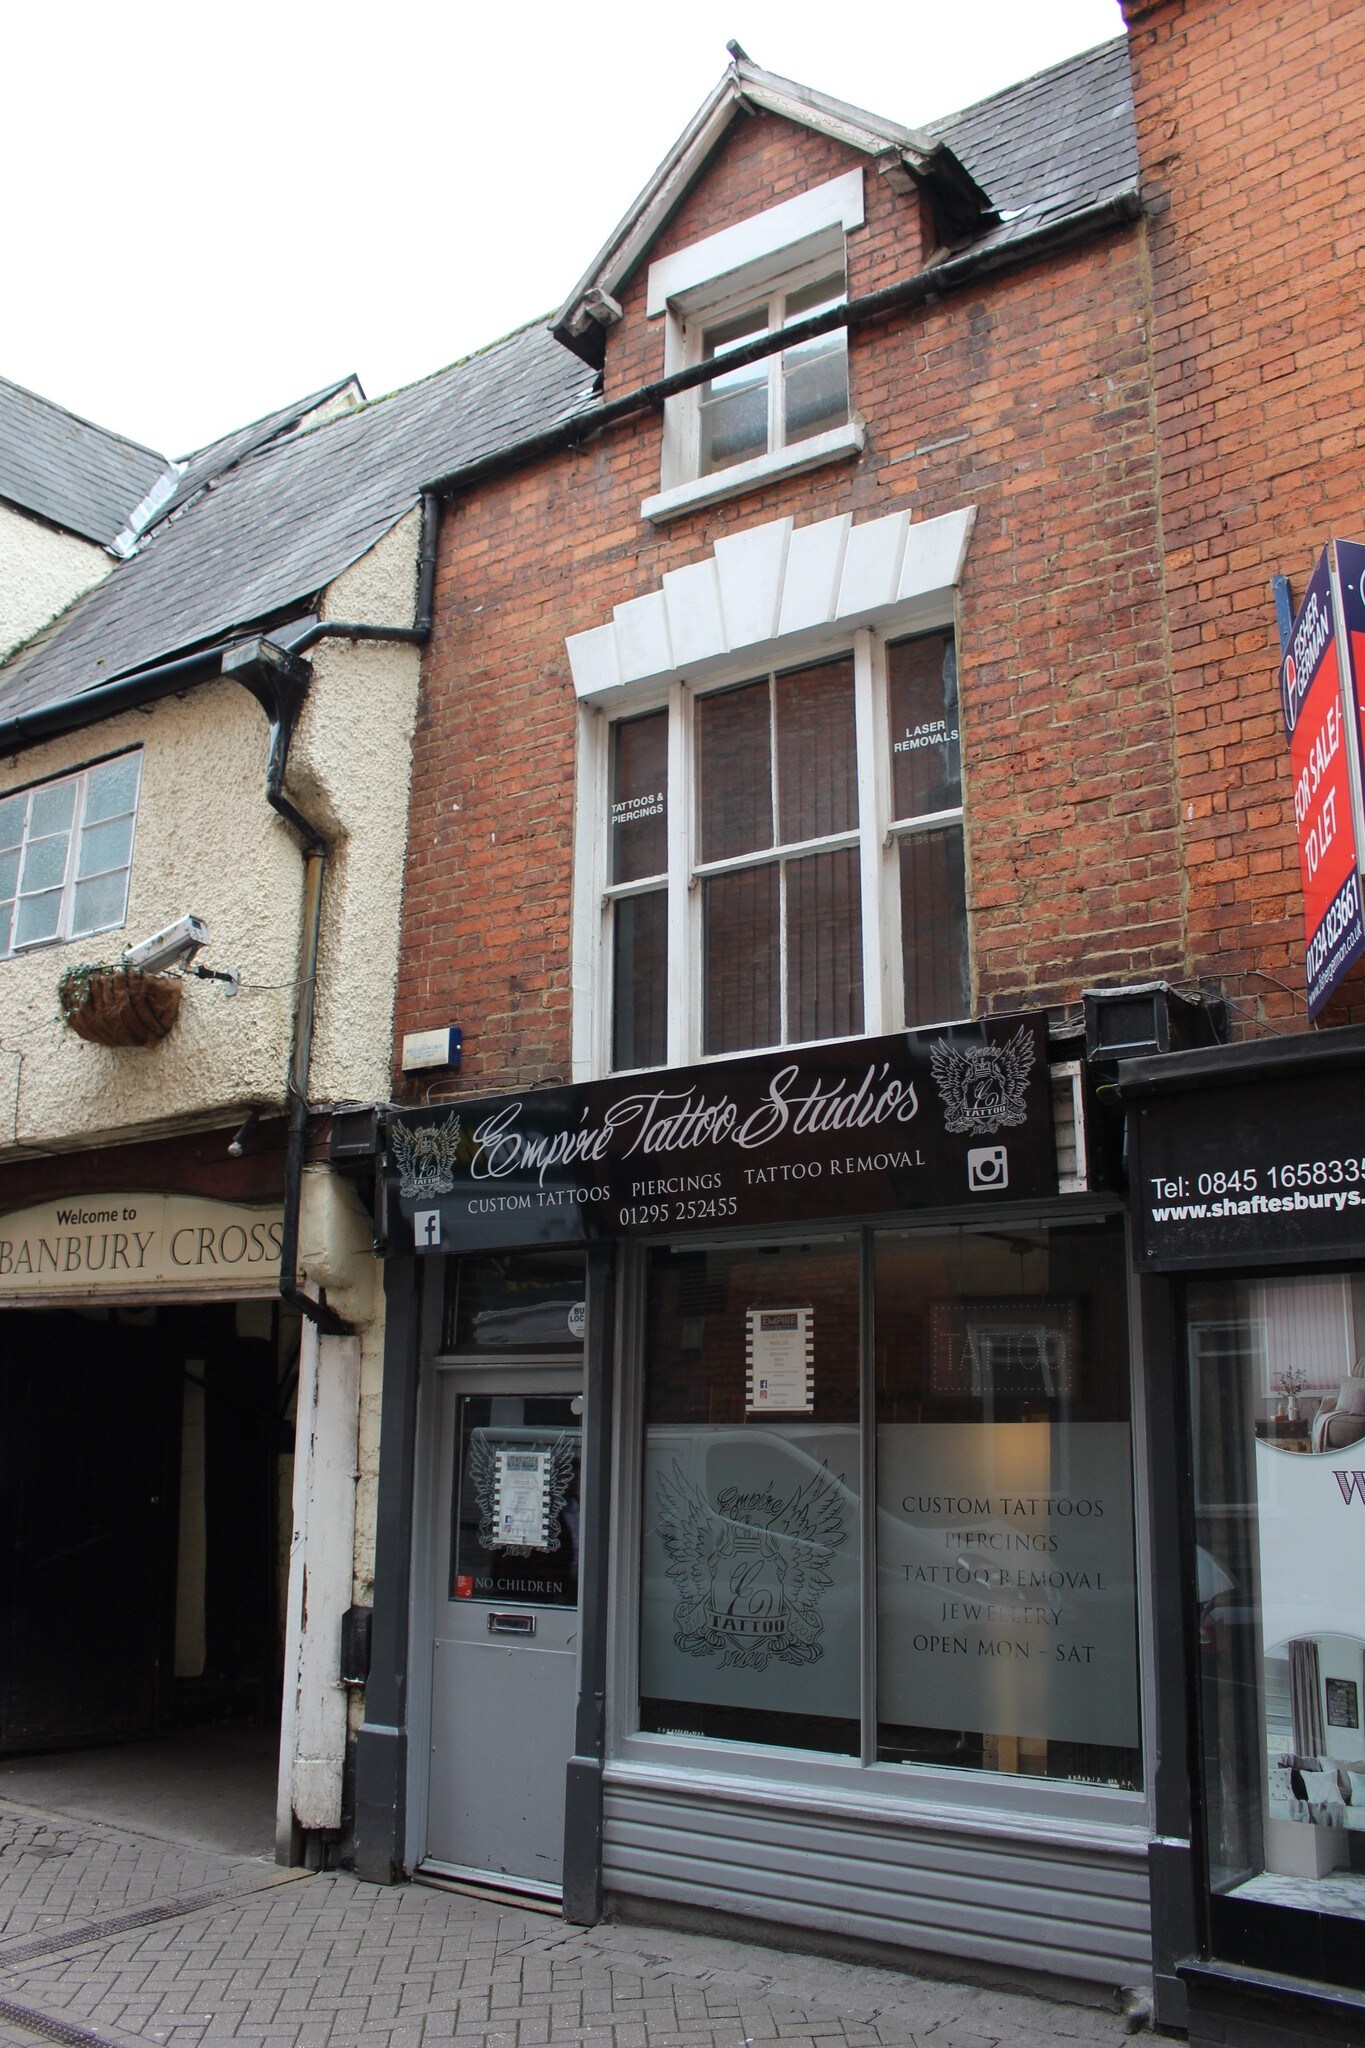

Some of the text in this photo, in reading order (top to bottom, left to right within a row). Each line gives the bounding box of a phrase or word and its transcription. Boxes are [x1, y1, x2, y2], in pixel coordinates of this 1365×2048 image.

[1293, 592, 1319, 669] FISHER
[1297, 605, 1329, 697] GERMAN
[894, 729, 959, 752] REMOVALS
[905, 720, 945, 738] LASER
[611, 792, 664, 813] TATTOOS &
[1294, 766, 1311, 834] FOR
[611, 804, 664, 825] PIERCINGS
[1305, 785, 1337, 882] TO LET
[1306, 873, 1359, 983] 01234 823661
[964, 1105, 1006, 1117] TATTOO
[470, 1062, 919, 1188] Empire Tattoo Studios
[413, 1176, 440, 1185] TATTOO
[468, 1150, 926, 1214] CUSTOM TATTOOS PIERCINGS TATTOO REMOVAL
[1151, 1175, 1190, 1199] Tel:
[1198, 1168, 1258, 1196] 0845
[57, 1207, 137, 1225] Welcome to
[619, 1197, 738, 1226] 01295 252455
[1151, 1190, 1365, 1222] www.shaftesburys.
[0, 1222, 284, 1275] BANBURY CROSS
[762, 1315, 796, 1326] EMPIRE
[940, 1330, 1066, 1371] TATTOO
[716, 1480, 784, 1515] Empire
[902, 1496, 1105, 1517] CUSTOM TATTOOS
[944, 1531, 1058, 1552] PIERCINGS
[475, 1577, 493, 1589] NO
[497, 1578, 563, 1594] CHILDREN
[901, 1564, 1107, 1590] TATTOO REMOVAL
[710, 1615, 785, 1633] TATTOO
[941, 1602, 1064, 1626] JEWELLERY
[913, 1634, 968, 1654] OPEN
[977, 1638, 1030, 1658] MON
[1055, 1643, 1096, 1663] SAT
